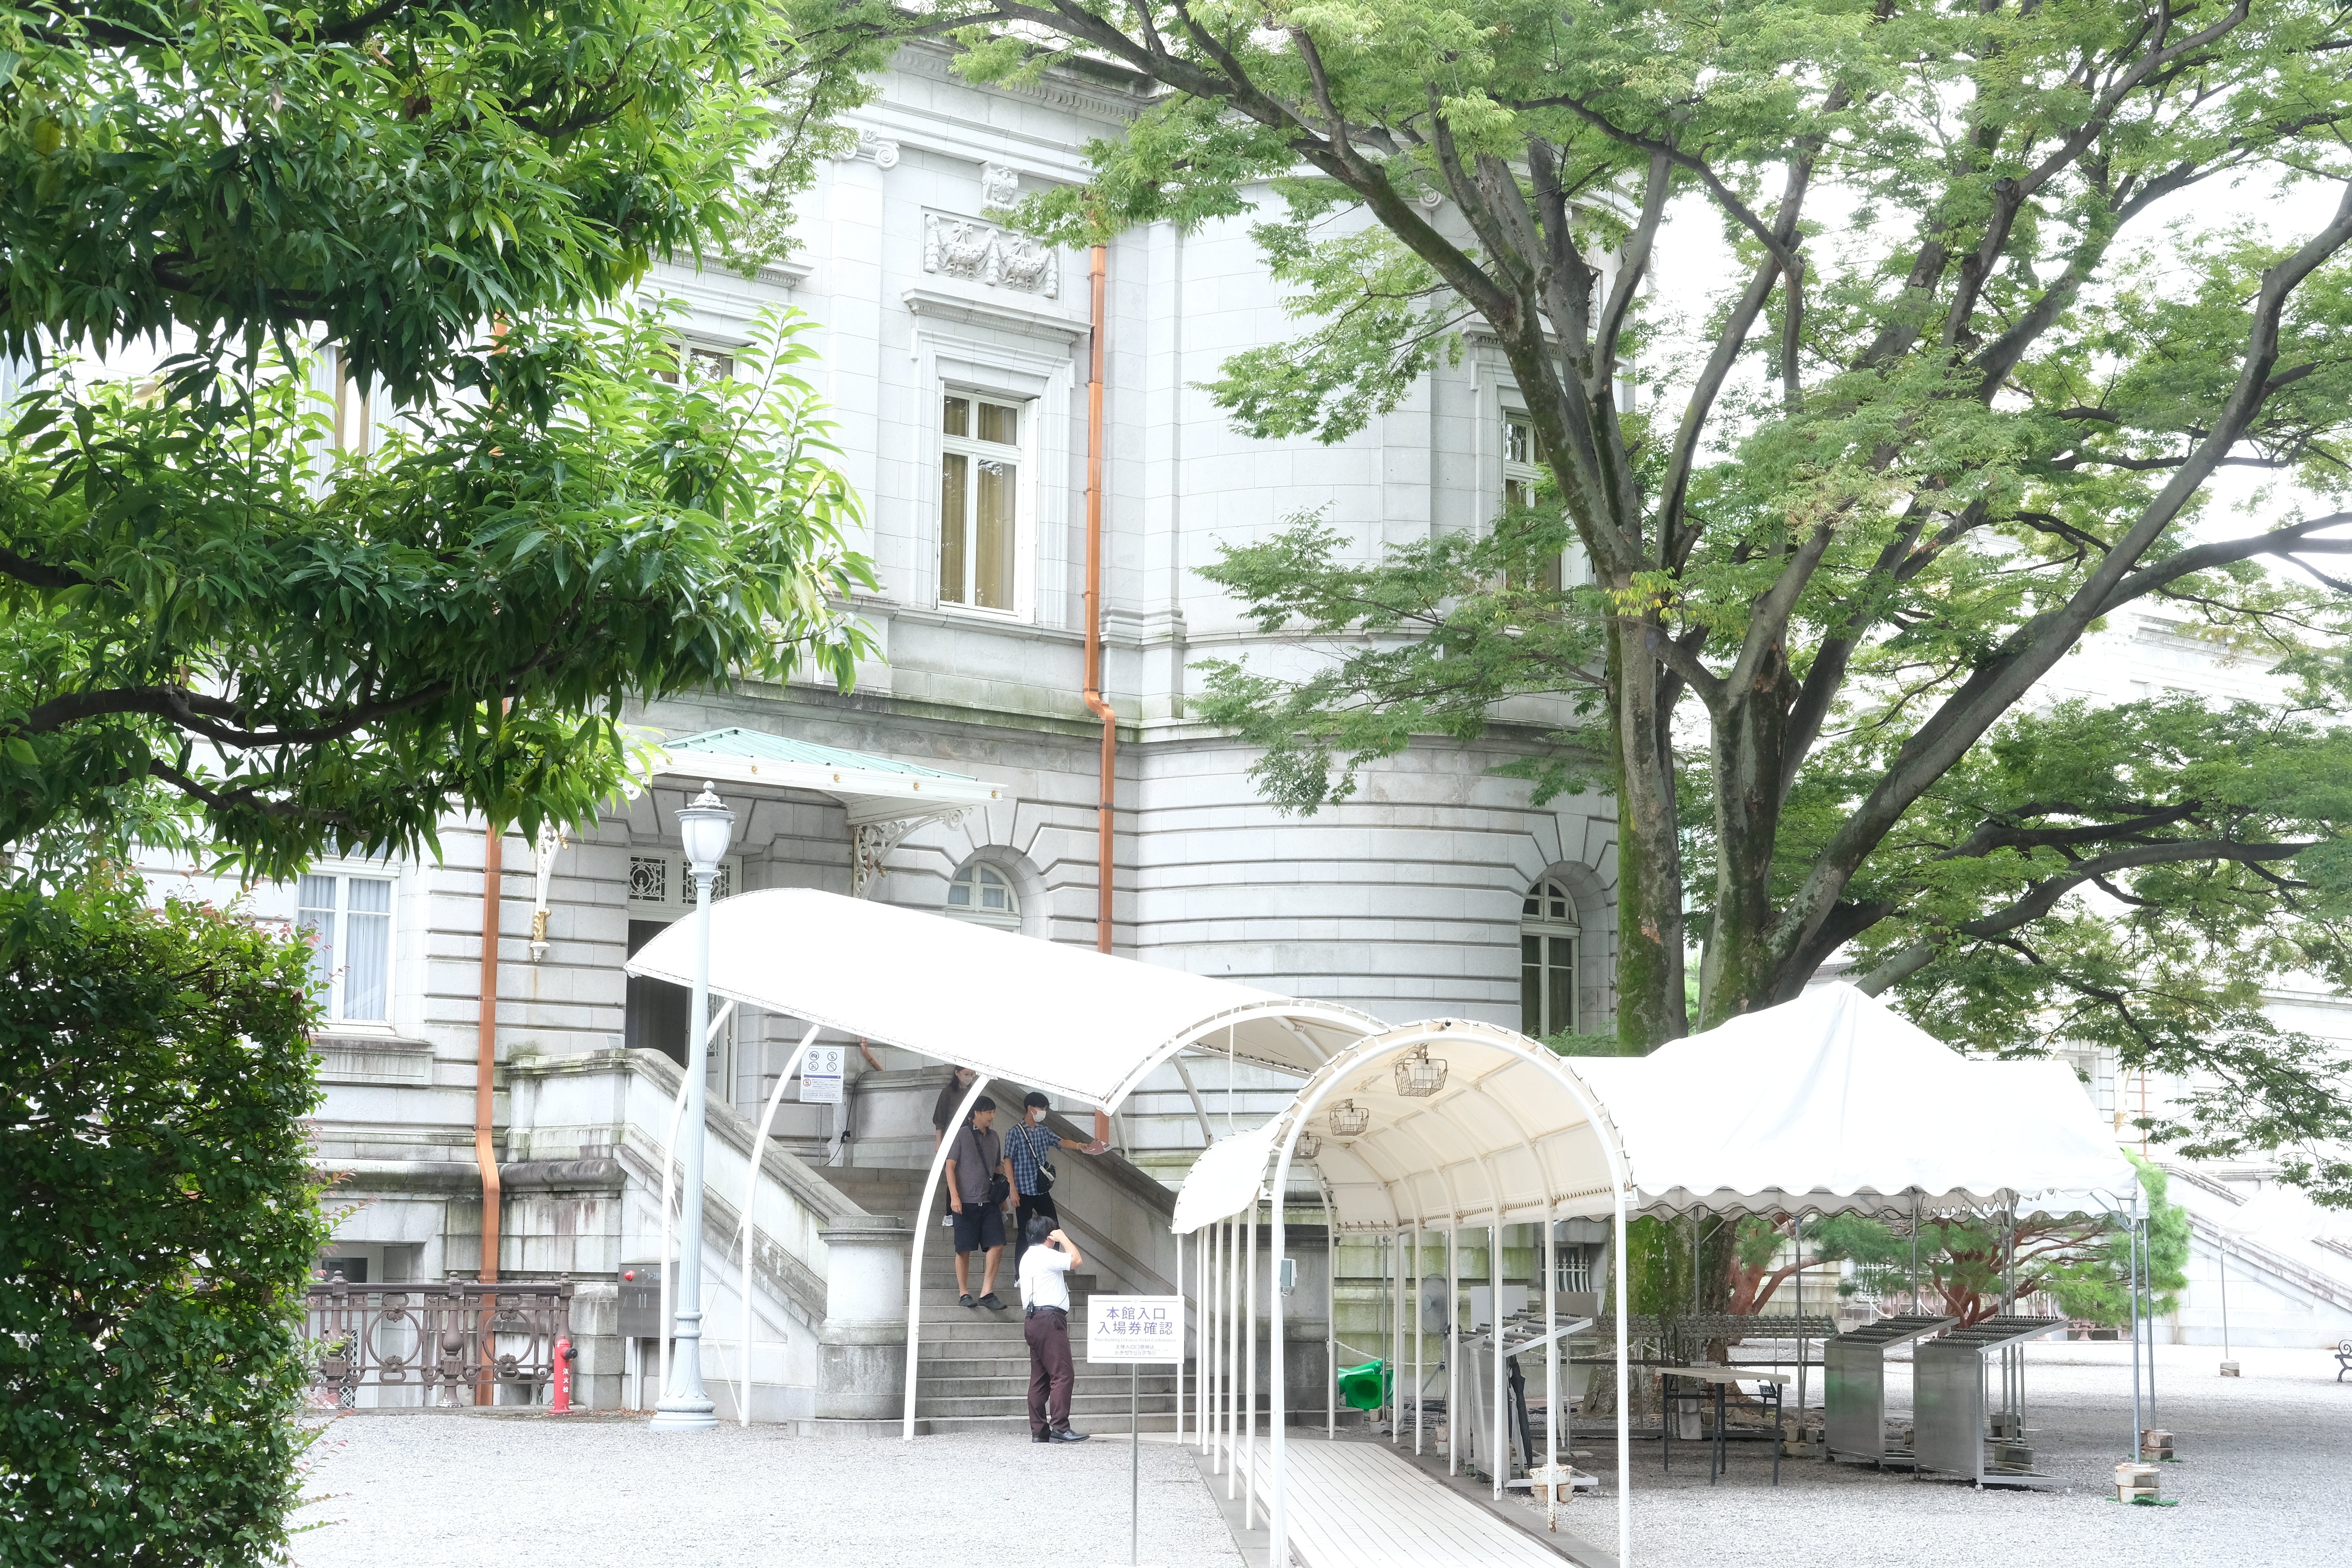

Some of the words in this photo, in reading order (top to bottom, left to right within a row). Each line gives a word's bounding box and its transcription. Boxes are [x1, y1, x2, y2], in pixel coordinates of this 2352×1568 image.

[1106, 1306, 1165, 1320] 本館入口
[1097, 1321, 1173, 1335] 入場券確認
